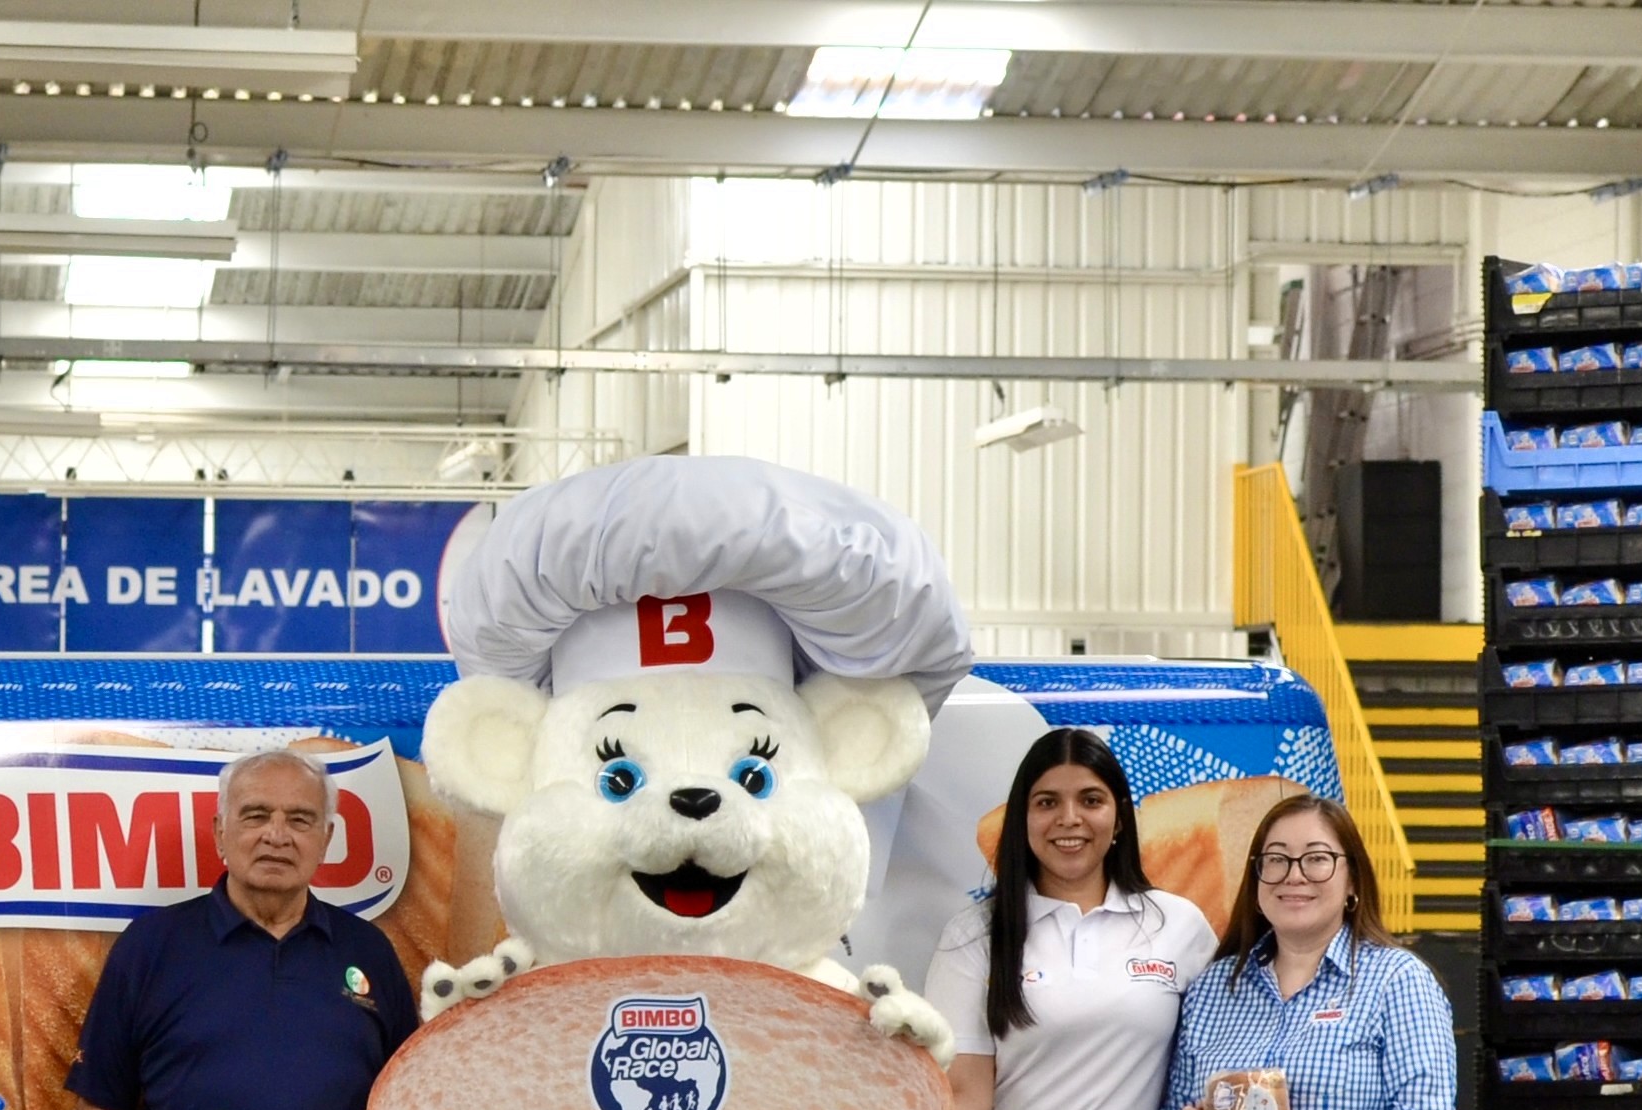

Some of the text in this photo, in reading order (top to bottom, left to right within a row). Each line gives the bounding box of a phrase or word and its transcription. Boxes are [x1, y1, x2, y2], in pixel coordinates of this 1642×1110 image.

[107, 566, 177, 605] DE
[197, 568, 422, 608] LAVADO
[636, 591, 715, 667] B
[621, 1009, 697, 1028] BIMBO
[630, 1037, 710, 1060] Global
[611, 1056, 676, 1079] Race
